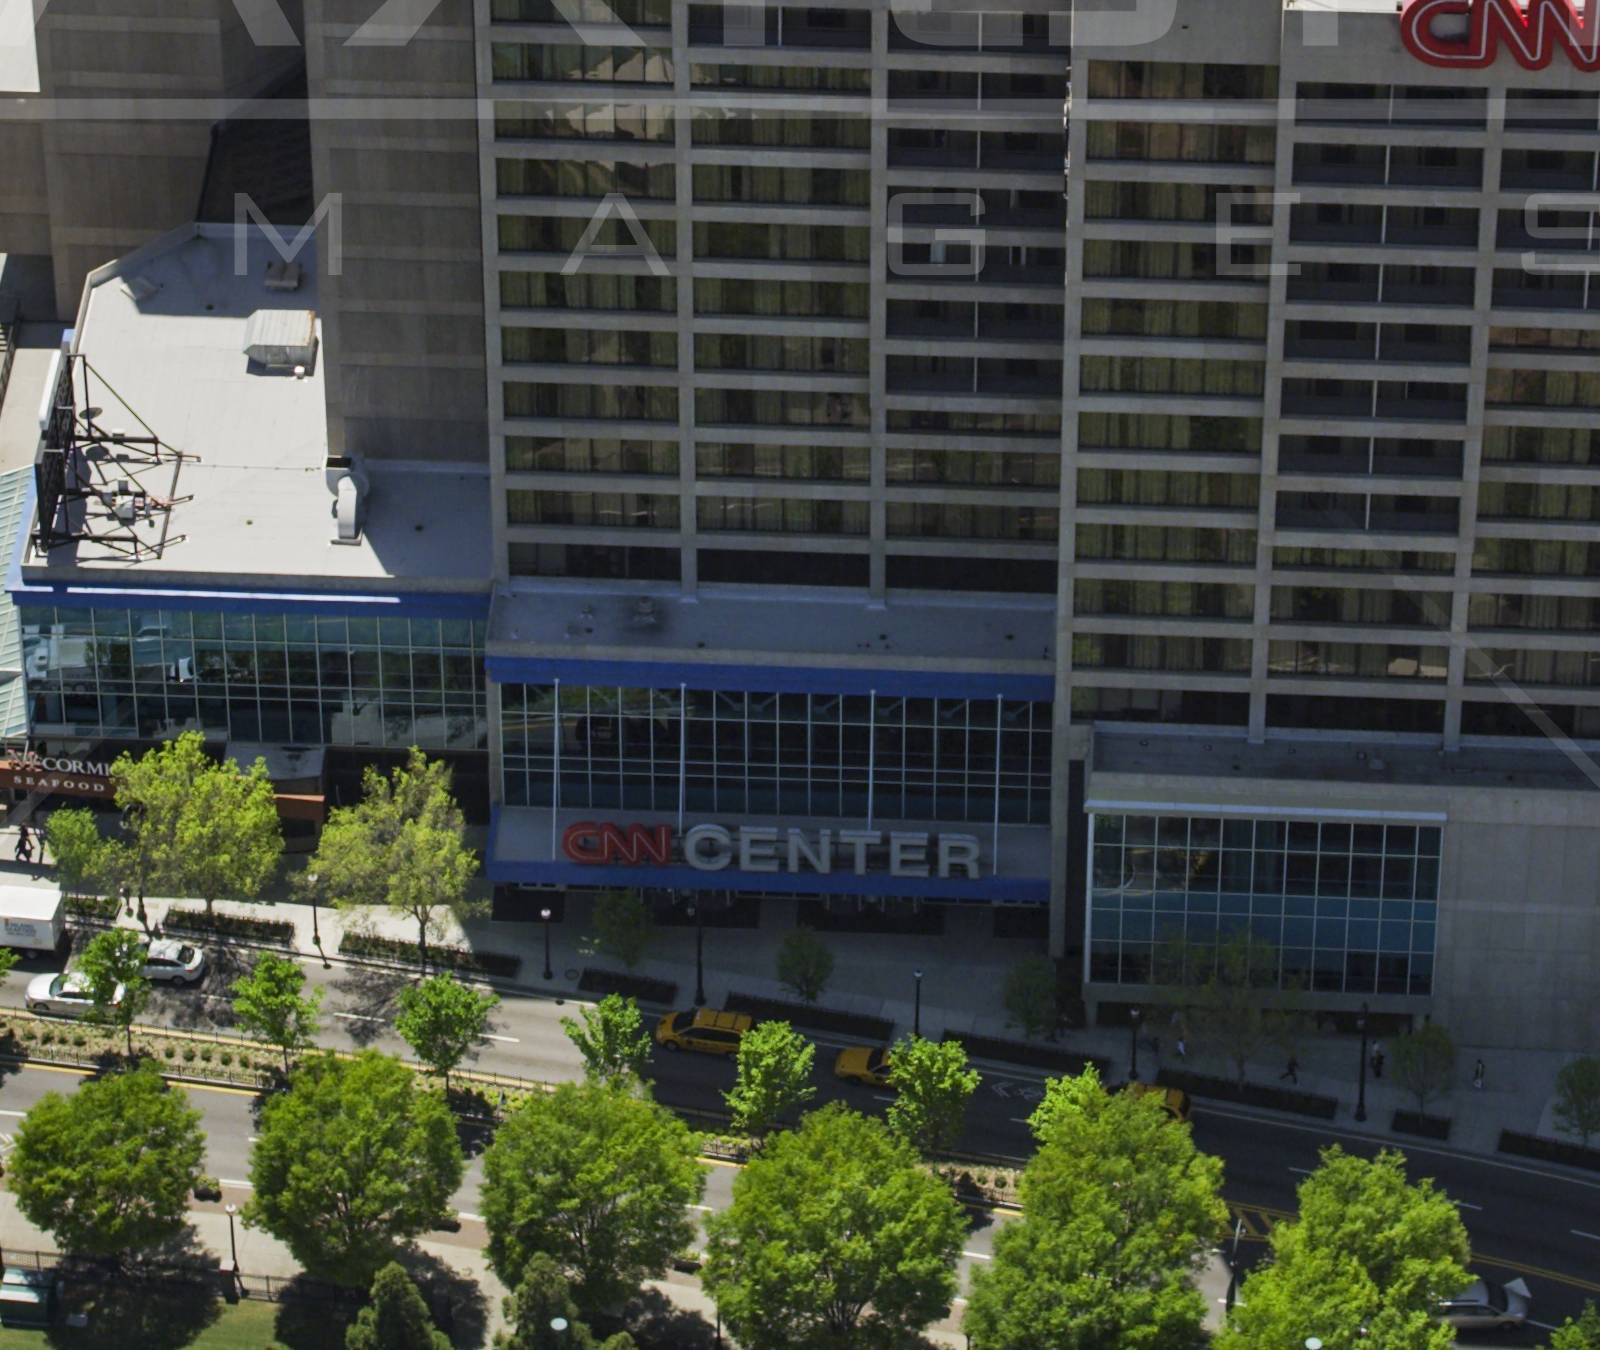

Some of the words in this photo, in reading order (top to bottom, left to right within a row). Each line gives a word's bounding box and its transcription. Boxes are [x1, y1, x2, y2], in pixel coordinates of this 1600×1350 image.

[13, 775, 106, 793] SEAFOOD
[562, 821, 672, 867] CNN
[683, 824, 980, 880] CENTER
